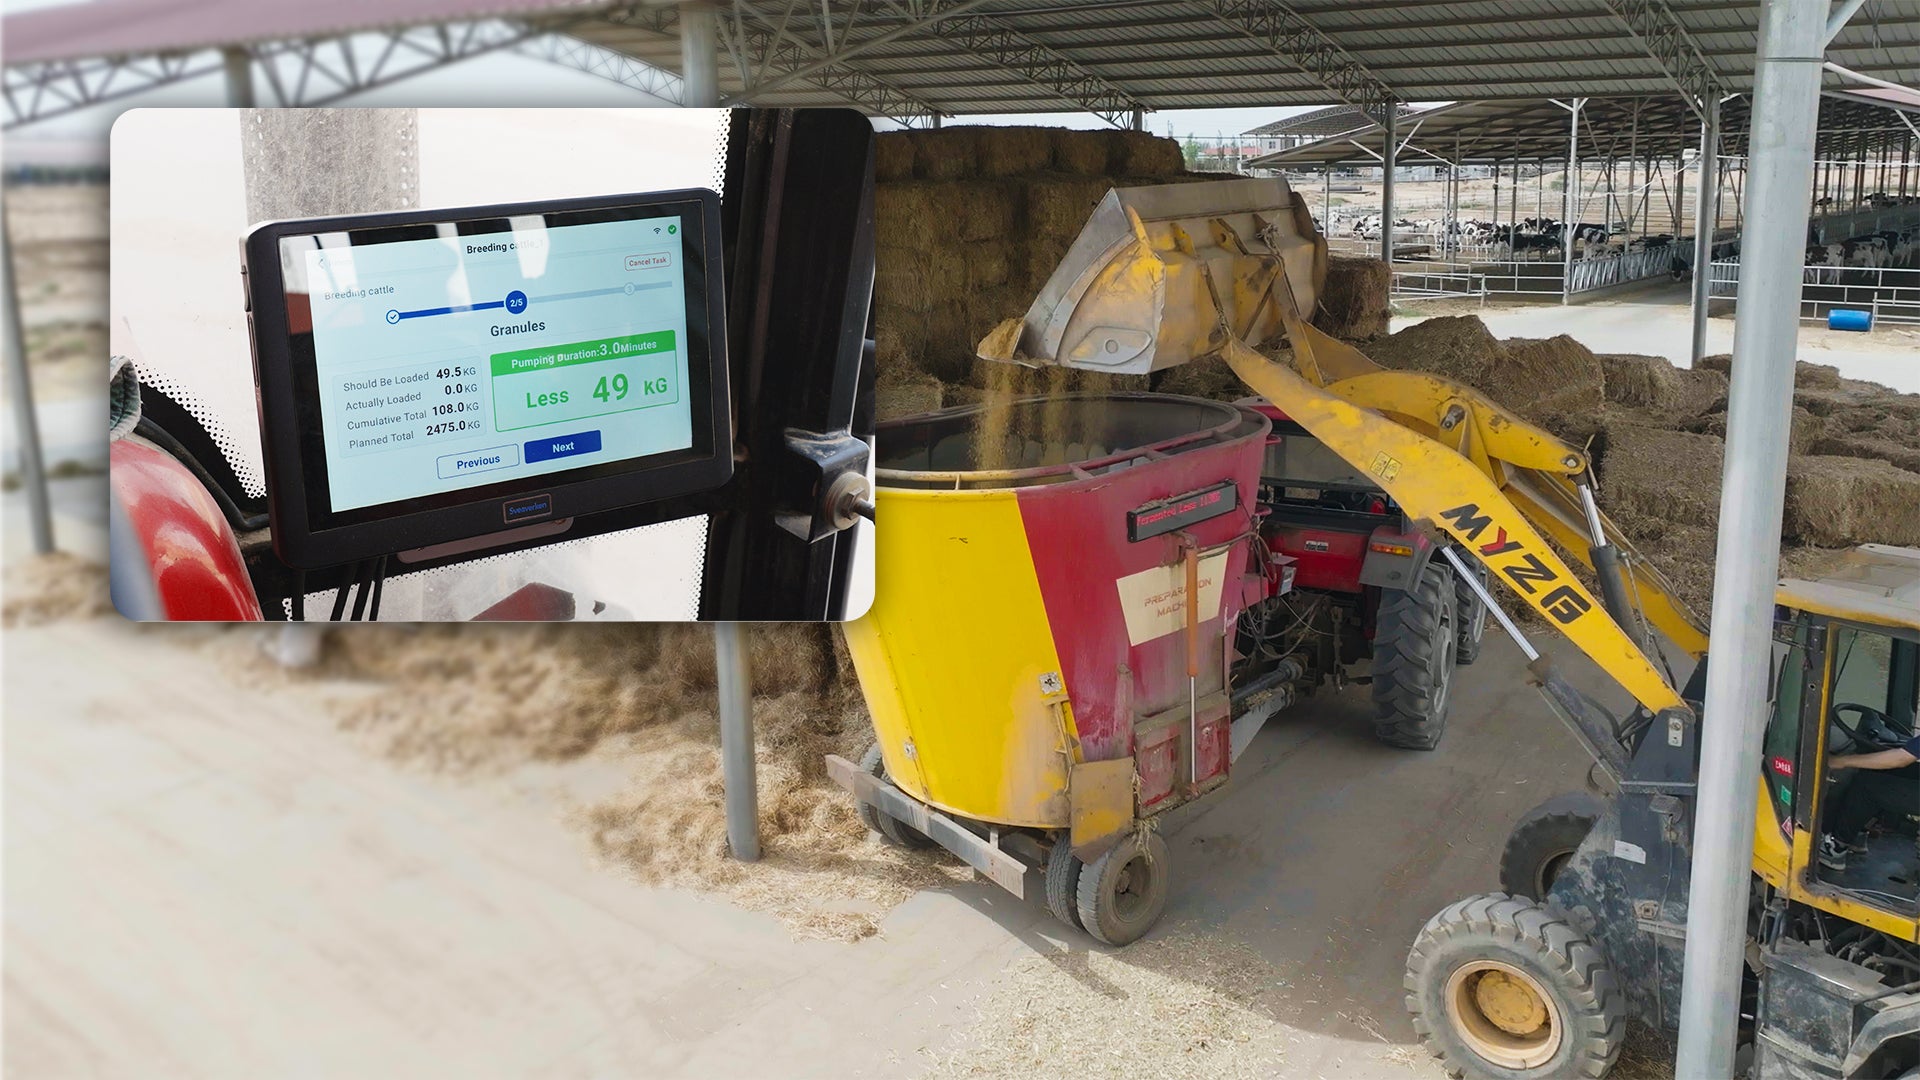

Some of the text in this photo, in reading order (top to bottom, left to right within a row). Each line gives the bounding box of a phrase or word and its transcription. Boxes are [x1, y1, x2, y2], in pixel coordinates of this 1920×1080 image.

[467, 242, 507, 255] Breeding
[629, 256, 667, 266] Cancel Task
[325, 285, 394, 300] Breeding cattle
[510, 297, 523, 307] 2/5
[491, 320, 545, 336] Granules
[511, 353, 555, 369] Pumping
[343, 366, 476, 392] Should Be Loaded 49.5 KG
[345, 383, 478, 411] Actually Loaded 0.0 KG
[526, 373, 667, 408] Less 49 KG
[347, 402, 479, 430] Cumulative Total 108.0 KG
[349, 420, 481, 449] Planned Total 2475.0 KG
[552, 441, 574, 453] Next
[456, 453, 500, 470] Previous
[1144, 578, 1212, 606] PREPARON
